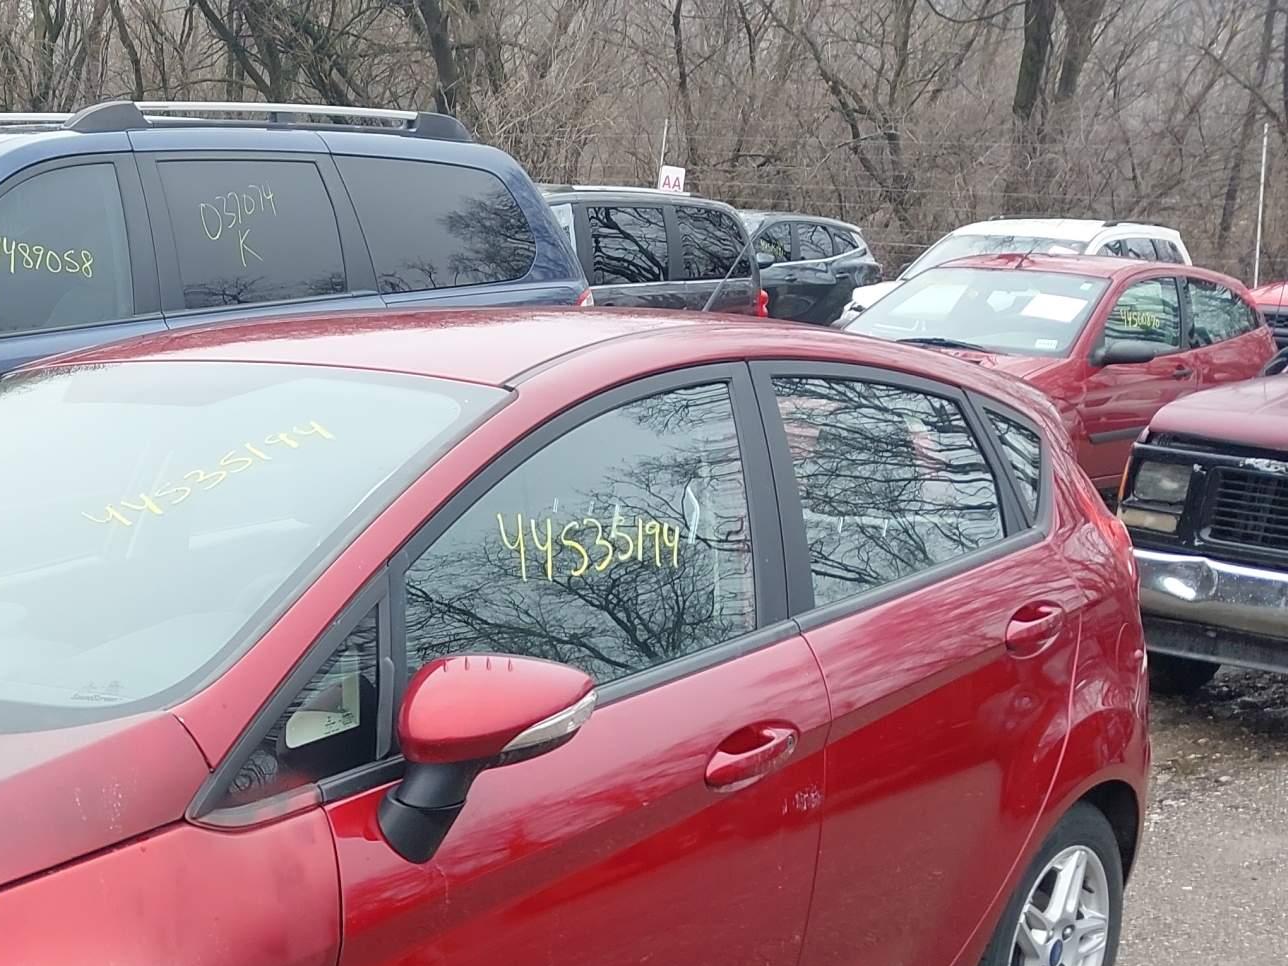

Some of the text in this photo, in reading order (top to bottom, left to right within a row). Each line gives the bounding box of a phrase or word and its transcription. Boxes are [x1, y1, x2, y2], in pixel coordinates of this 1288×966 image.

[238, 228, 264, 267] K
[81, 419, 335, 526] 44535194
[496, 512, 680, 582] 44535194
